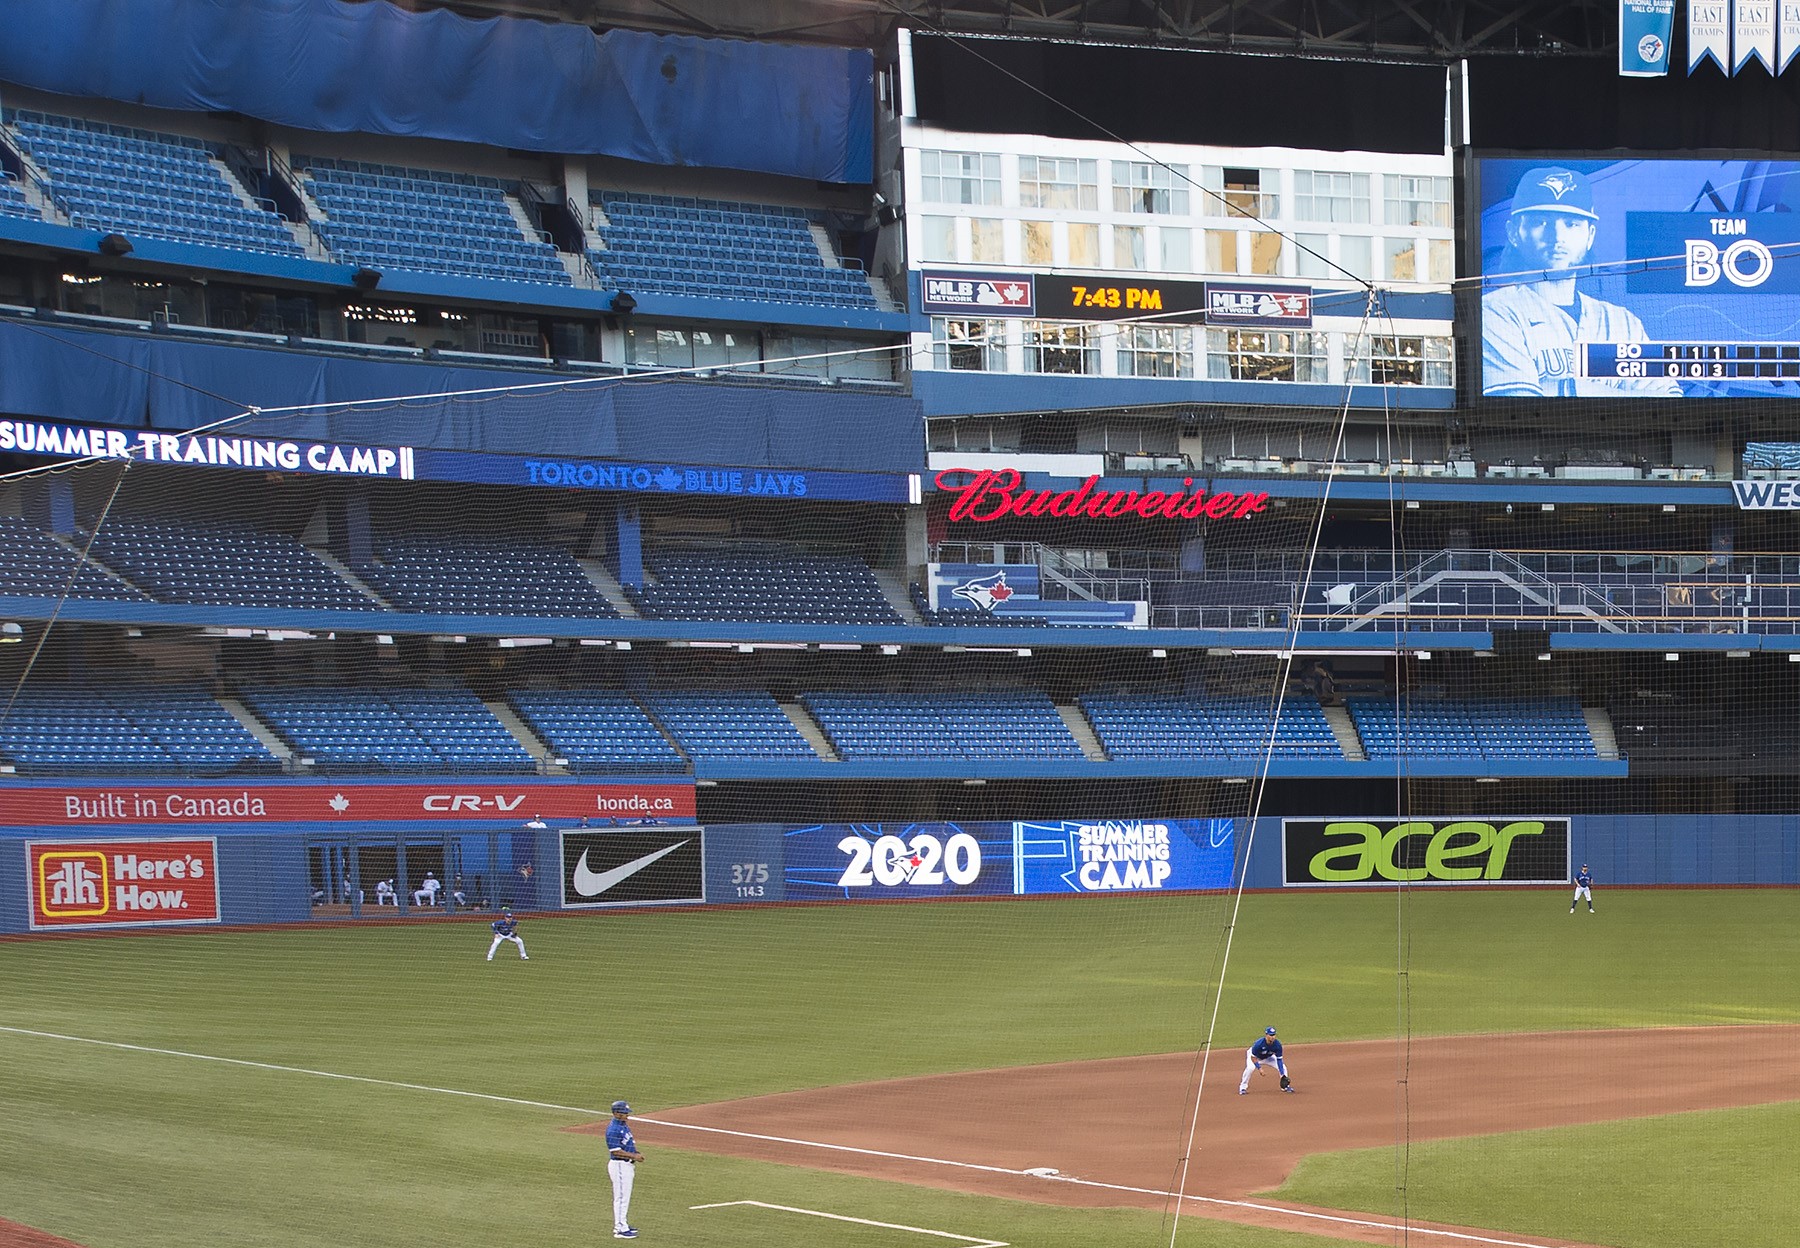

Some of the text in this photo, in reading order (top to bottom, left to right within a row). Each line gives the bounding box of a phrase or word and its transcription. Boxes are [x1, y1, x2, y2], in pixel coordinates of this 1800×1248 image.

[1693, 5, 1724, 23] EAST
[1739, 5, 1770, 23] EAST
[1692, 27, 1724, 36] CHAMPS
[1738, 27, 1770, 37] CHAMPS
[1709, 217, 1746, 236] TEAM
[1684, 238, 1774, 288] BO
[928, 280, 973, 297] MLB
[929, 294, 973, 304] NETWORK
[1072, 286, 1163, 310] 7:43 PM
[1213, 291, 1254, 308] MLB
[1616, 343, 1720, 360] BO 1 1 1
[1616, 361, 1723, 377] GRI 0 0 3
[0, 421, 398, 475] SUMMER TRAINING CAMP
[525, 460, 807, 497] TORONTO BLUE JAYS
[935, 468, 1269, 522] Budweiser
[65, 793, 266, 819] Built in Canada
[423, 795, 526, 812] CR-V
[597, 794, 674, 811] honda.ca
[1079, 824, 1170, 846] SUMMER
[837, 833, 982, 887] 2020
[1079, 845, 1170, 862] TRAINING
[1309, 821, 1545, 881] acer
[731, 864, 769, 884] 375
[1079, 862, 1171, 890] CAMP
[116, 885, 188, 911] How.
[736, 885, 764, 897] 114.3
